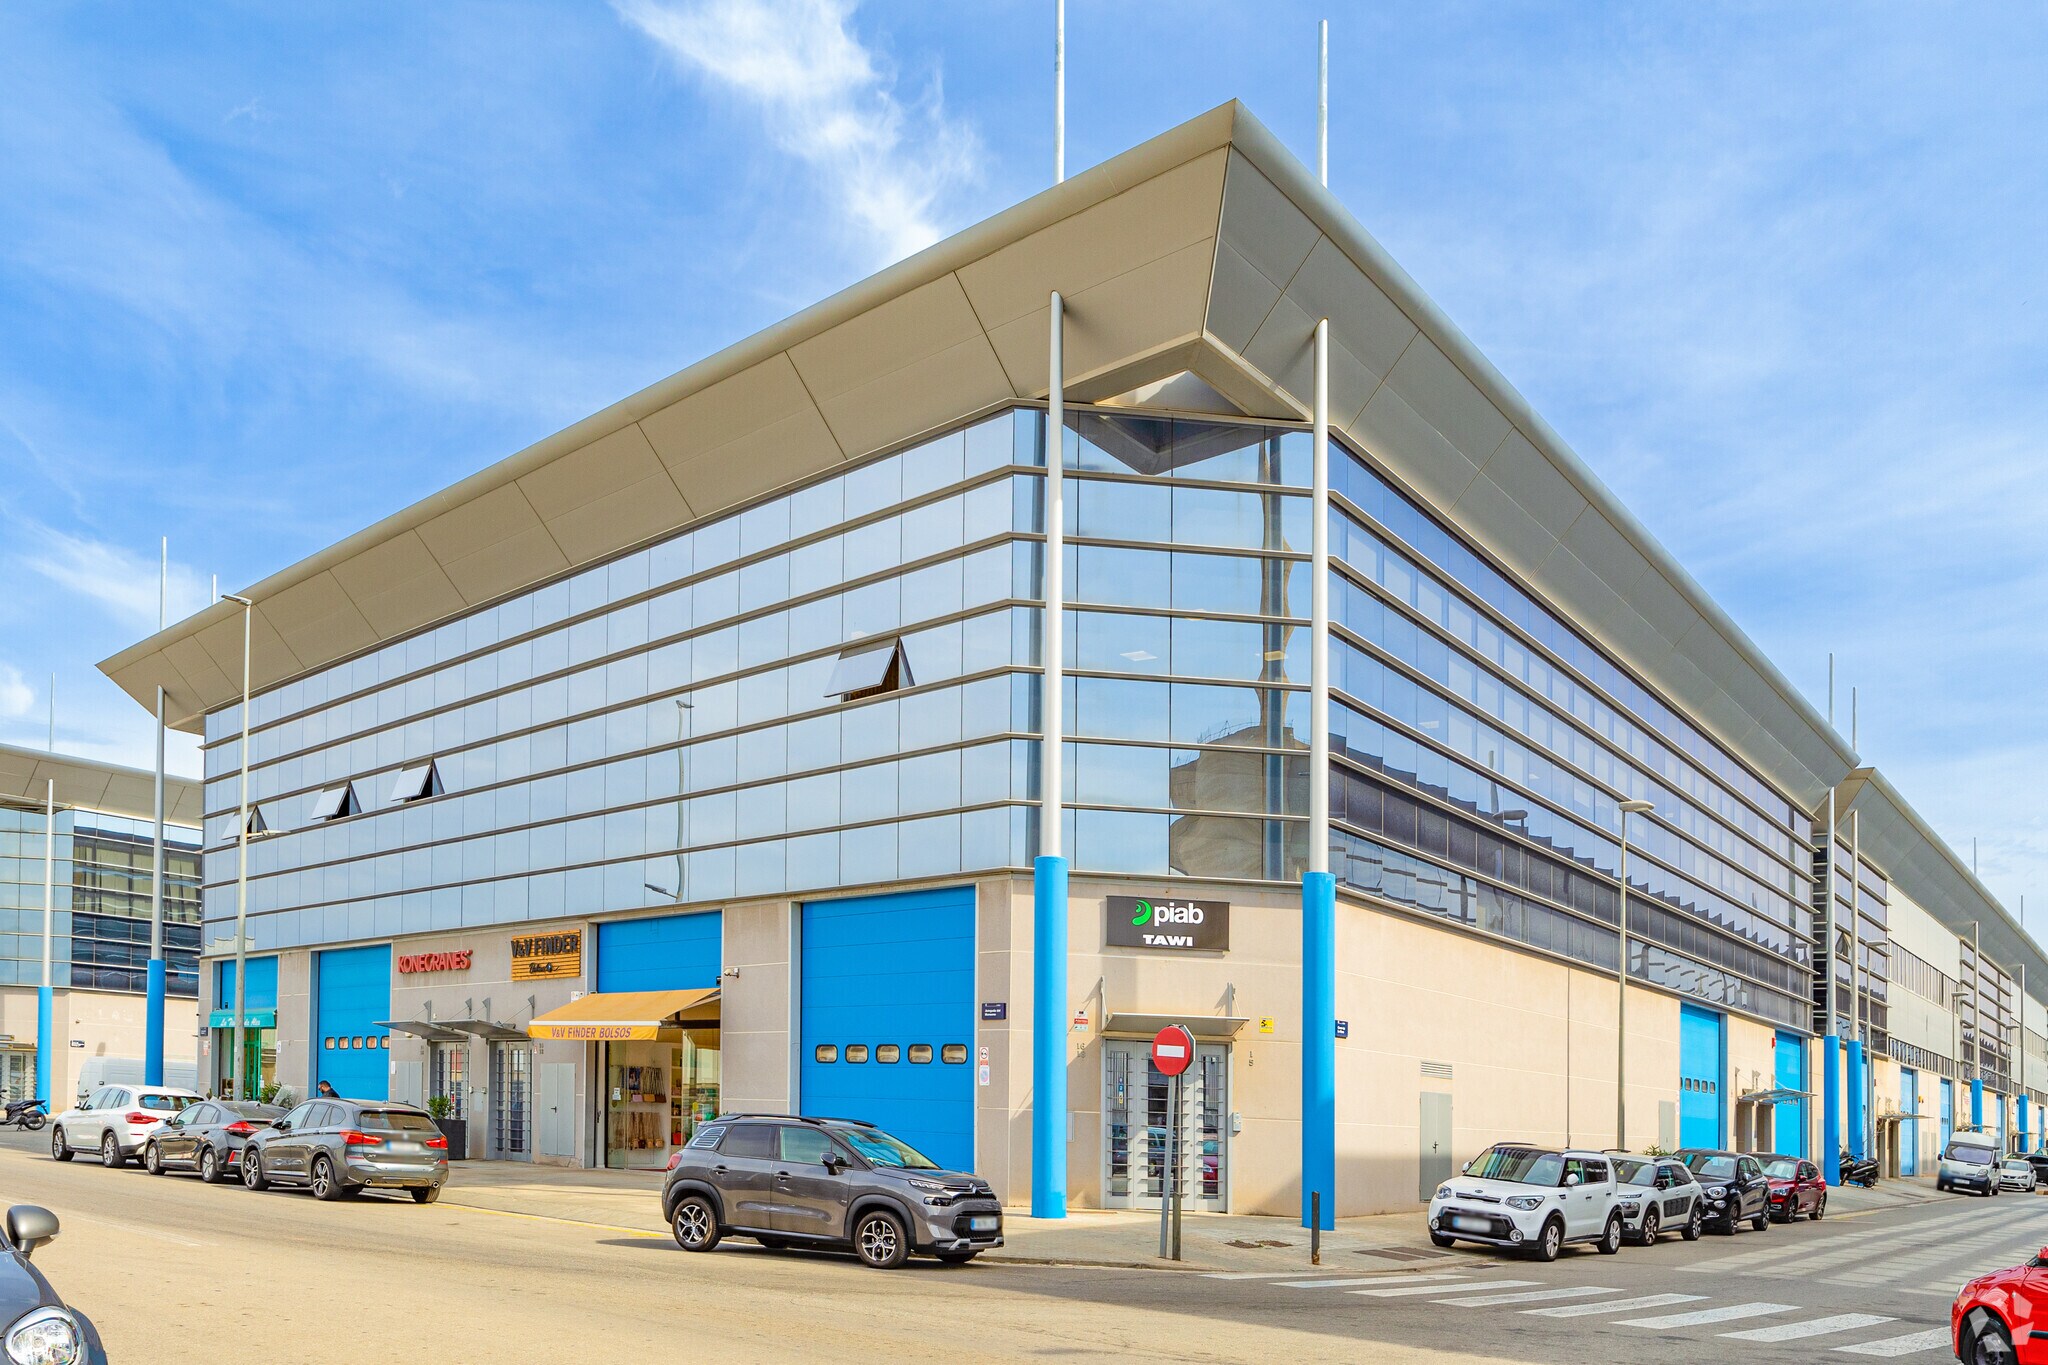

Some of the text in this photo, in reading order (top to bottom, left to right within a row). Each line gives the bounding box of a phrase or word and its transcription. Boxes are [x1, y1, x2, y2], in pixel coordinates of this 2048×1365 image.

[1154, 902, 1204, 927] piab
[511, 934, 578, 958] V&V FINDER
[1142, 934, 1193, 947] TAWI
[397, 949, 473, 974] KONECRANES
[551, 1027, 632, 1038] V&V FINDER BOLSOS
